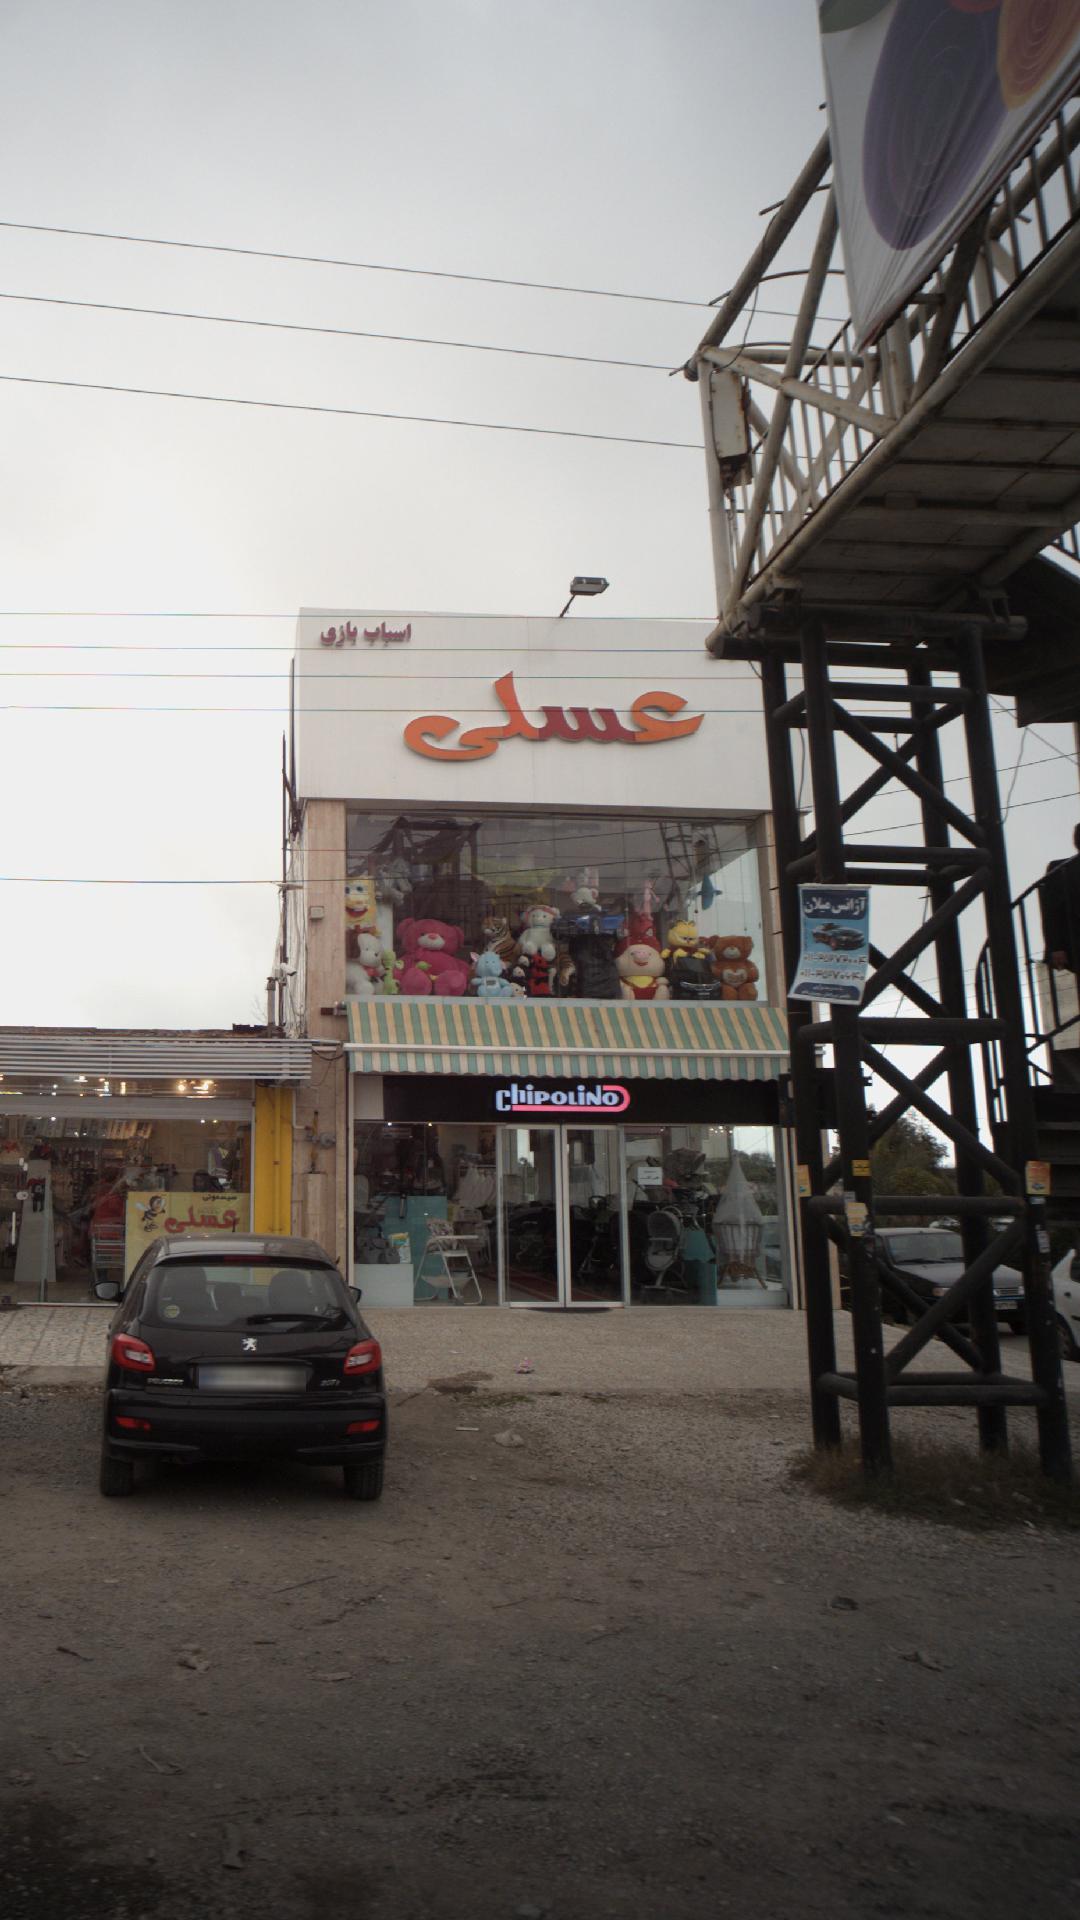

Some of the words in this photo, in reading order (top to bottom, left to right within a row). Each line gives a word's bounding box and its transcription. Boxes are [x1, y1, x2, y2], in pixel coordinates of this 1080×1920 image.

[320, 621, 358, 647] بازی
[364, 621, 411, 647] اسباب
[404, 671, 705, 762] عسلی
[831, 897, 867, 916] آژانس
[164, 1205, 240, 1234] عسلی
